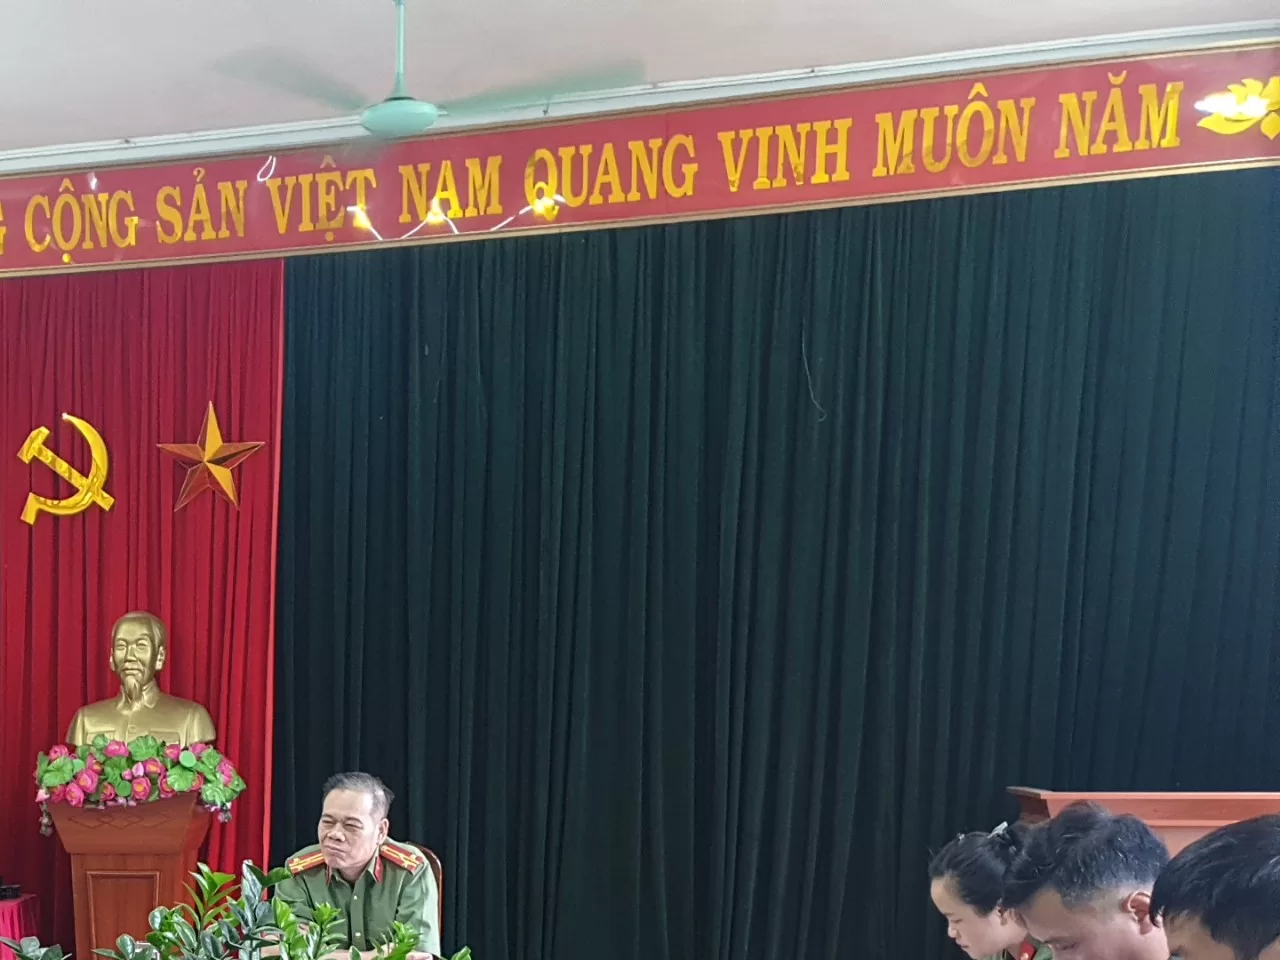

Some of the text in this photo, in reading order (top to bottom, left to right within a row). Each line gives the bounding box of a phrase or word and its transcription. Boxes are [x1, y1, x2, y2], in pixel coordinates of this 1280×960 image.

[24, 178, 138, 263] CỘNG
[156, 167, 247, 245] SẢN
[266, 155, 376, 241] VIỆT
[398, 155, 502, 223] NAM
[525, 134, 698, 220] QUANG
[719, 118, 852, 192] VINH
[874, 82, 1035, 176] MUÔN
[1055, 70, 1184, 157] NĂM
